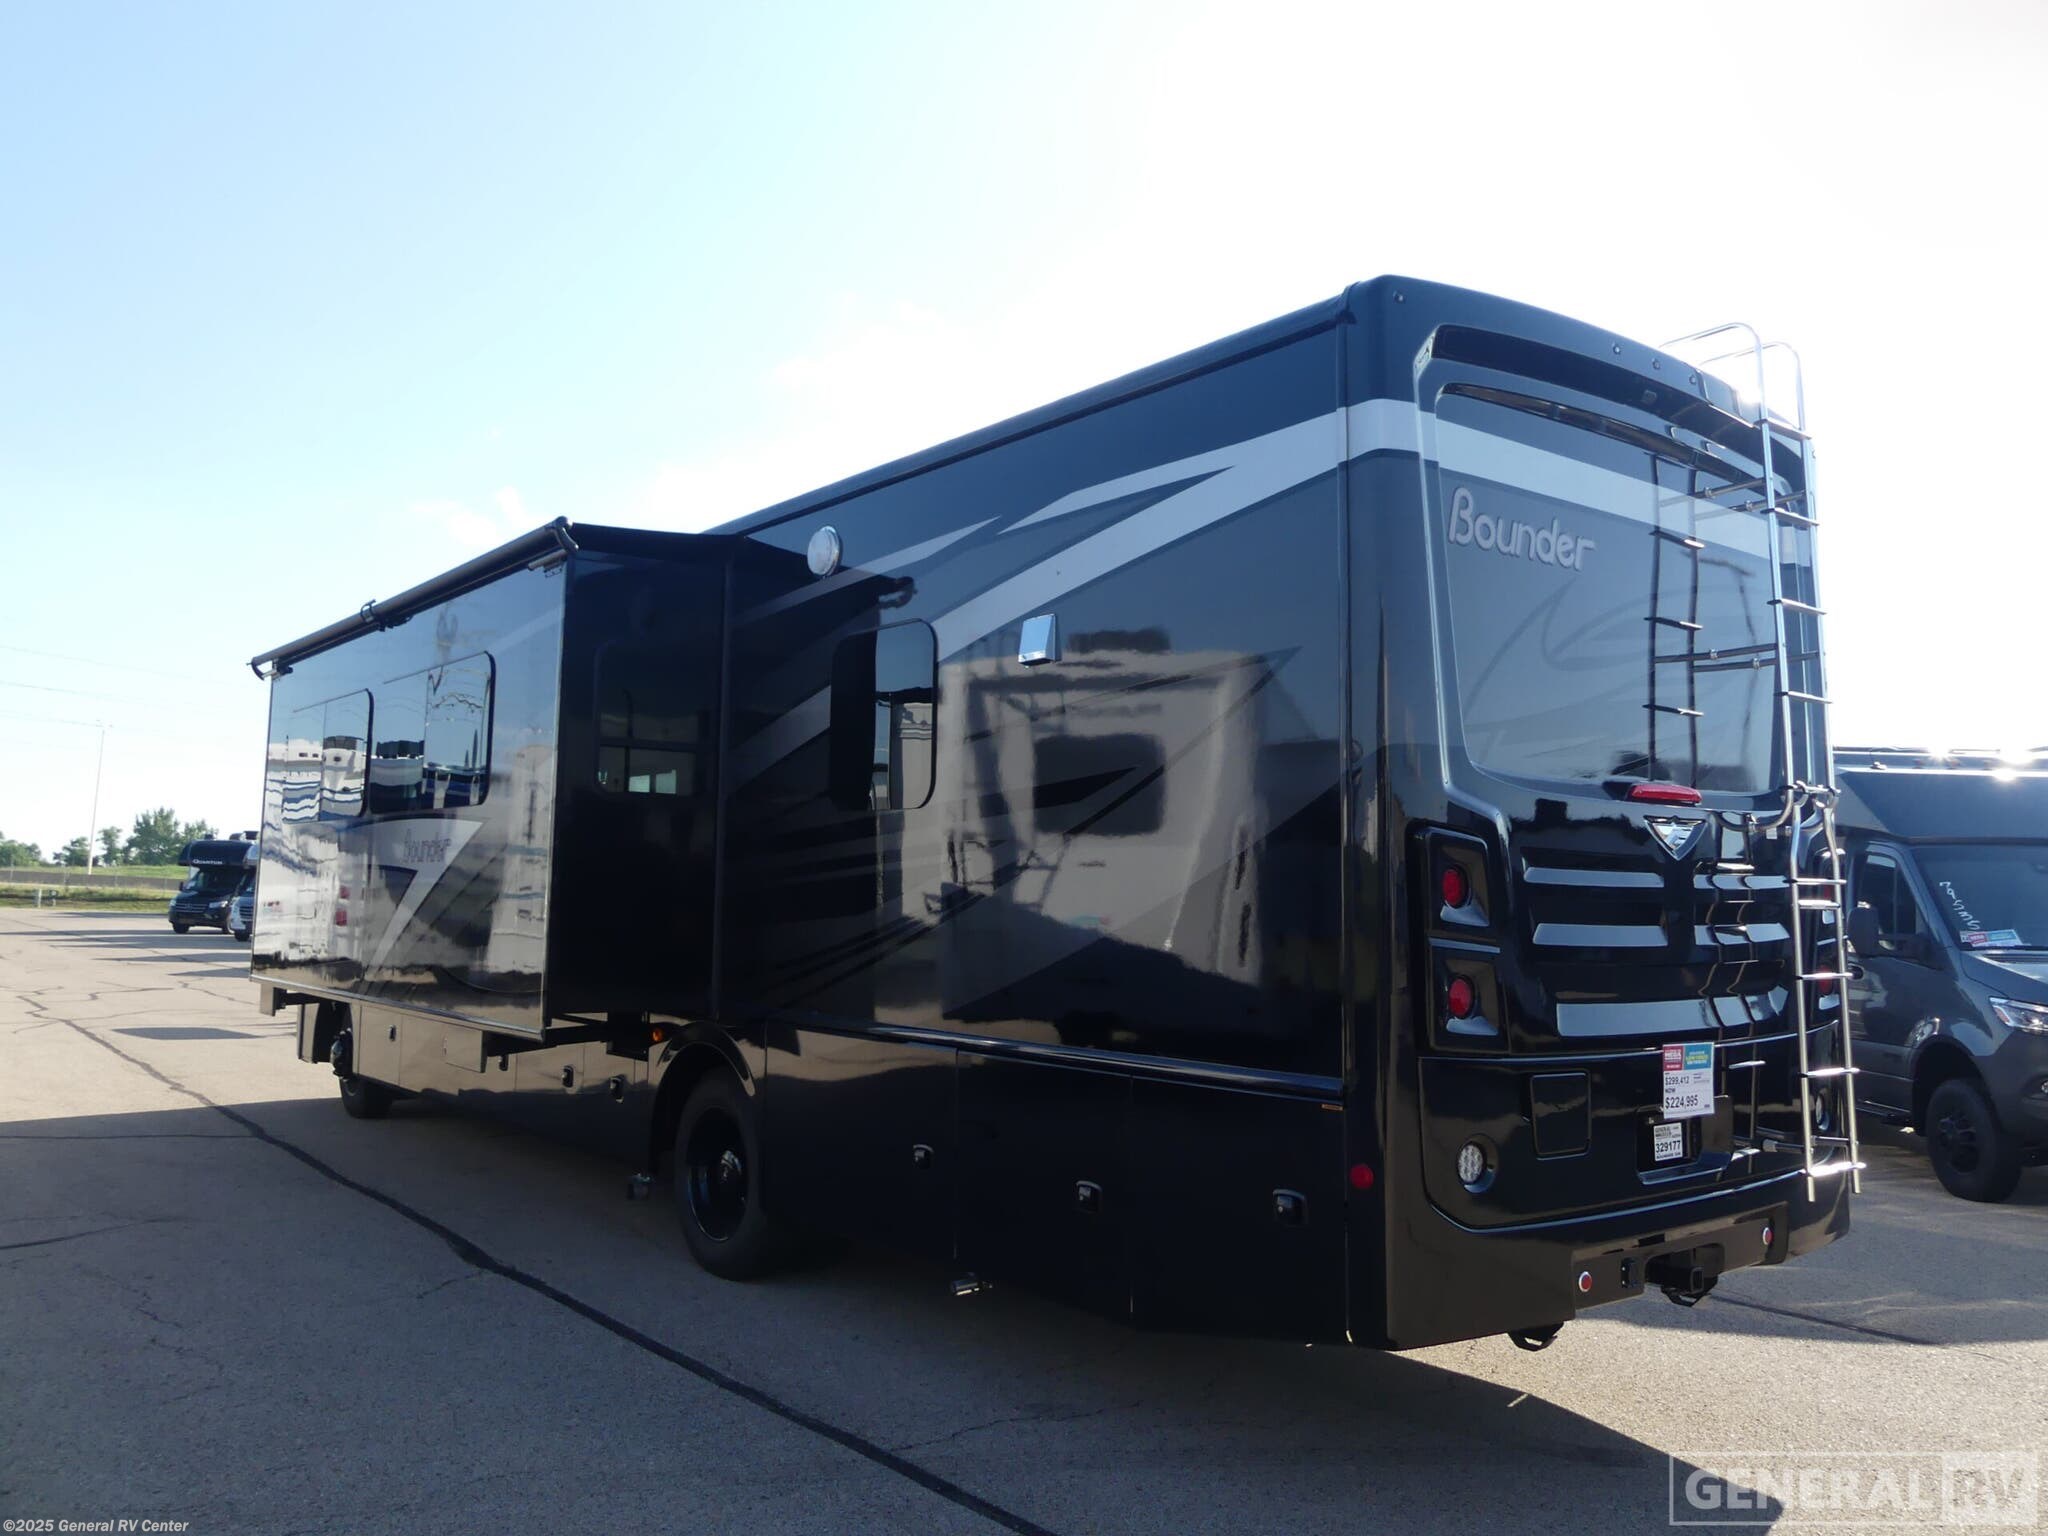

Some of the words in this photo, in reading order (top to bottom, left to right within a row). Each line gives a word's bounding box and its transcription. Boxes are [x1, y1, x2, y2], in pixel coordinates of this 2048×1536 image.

[1449, 486, 1595, 571] Bounder
[1665, 1094, 1699, 1110] $224,995
[1655, 1140, 1681, 1153] 329177
